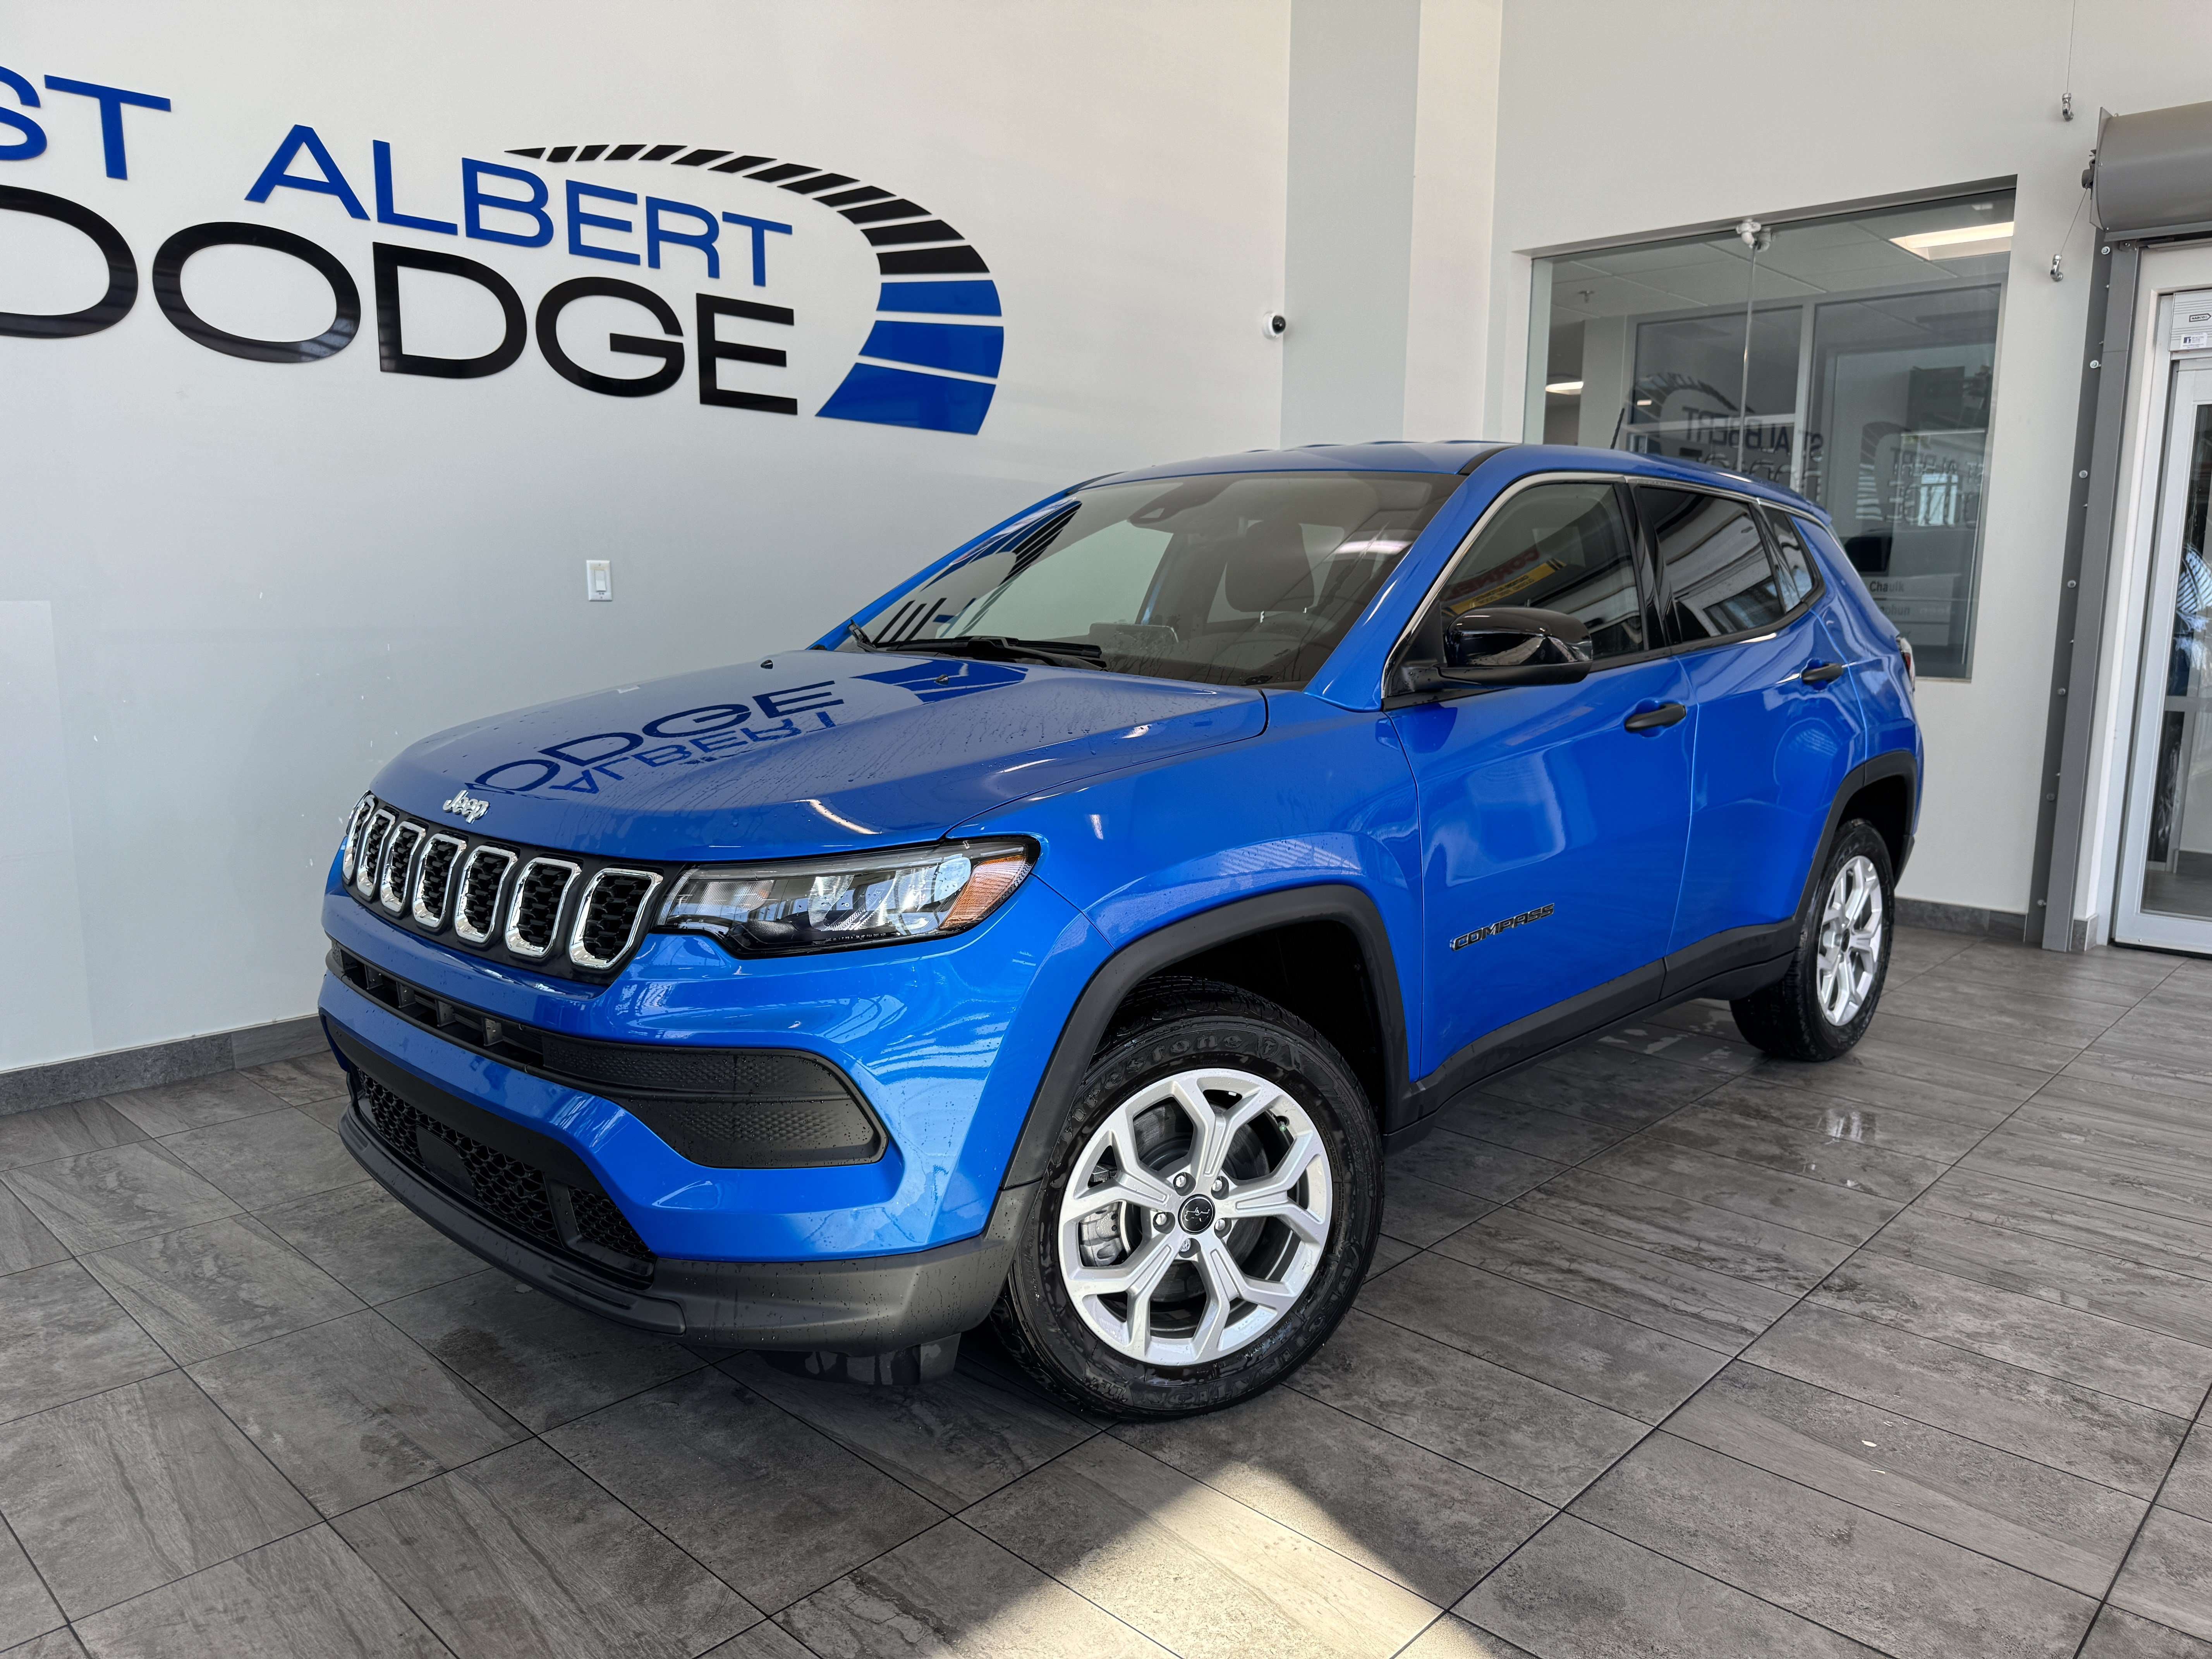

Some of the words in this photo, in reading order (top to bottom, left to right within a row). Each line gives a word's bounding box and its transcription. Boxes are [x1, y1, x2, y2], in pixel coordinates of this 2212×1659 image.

[244, 124, 792, 287] ALBERT
[0, 185, 798, 416] DODGE
[443, 790, 489, 824] Jeep
[1449, 903, 1555, 951] COMPASS
[1056, 1033, 1243, 1147] Firestone
[1135, 1262, 1355, 1407] DESTINATION
